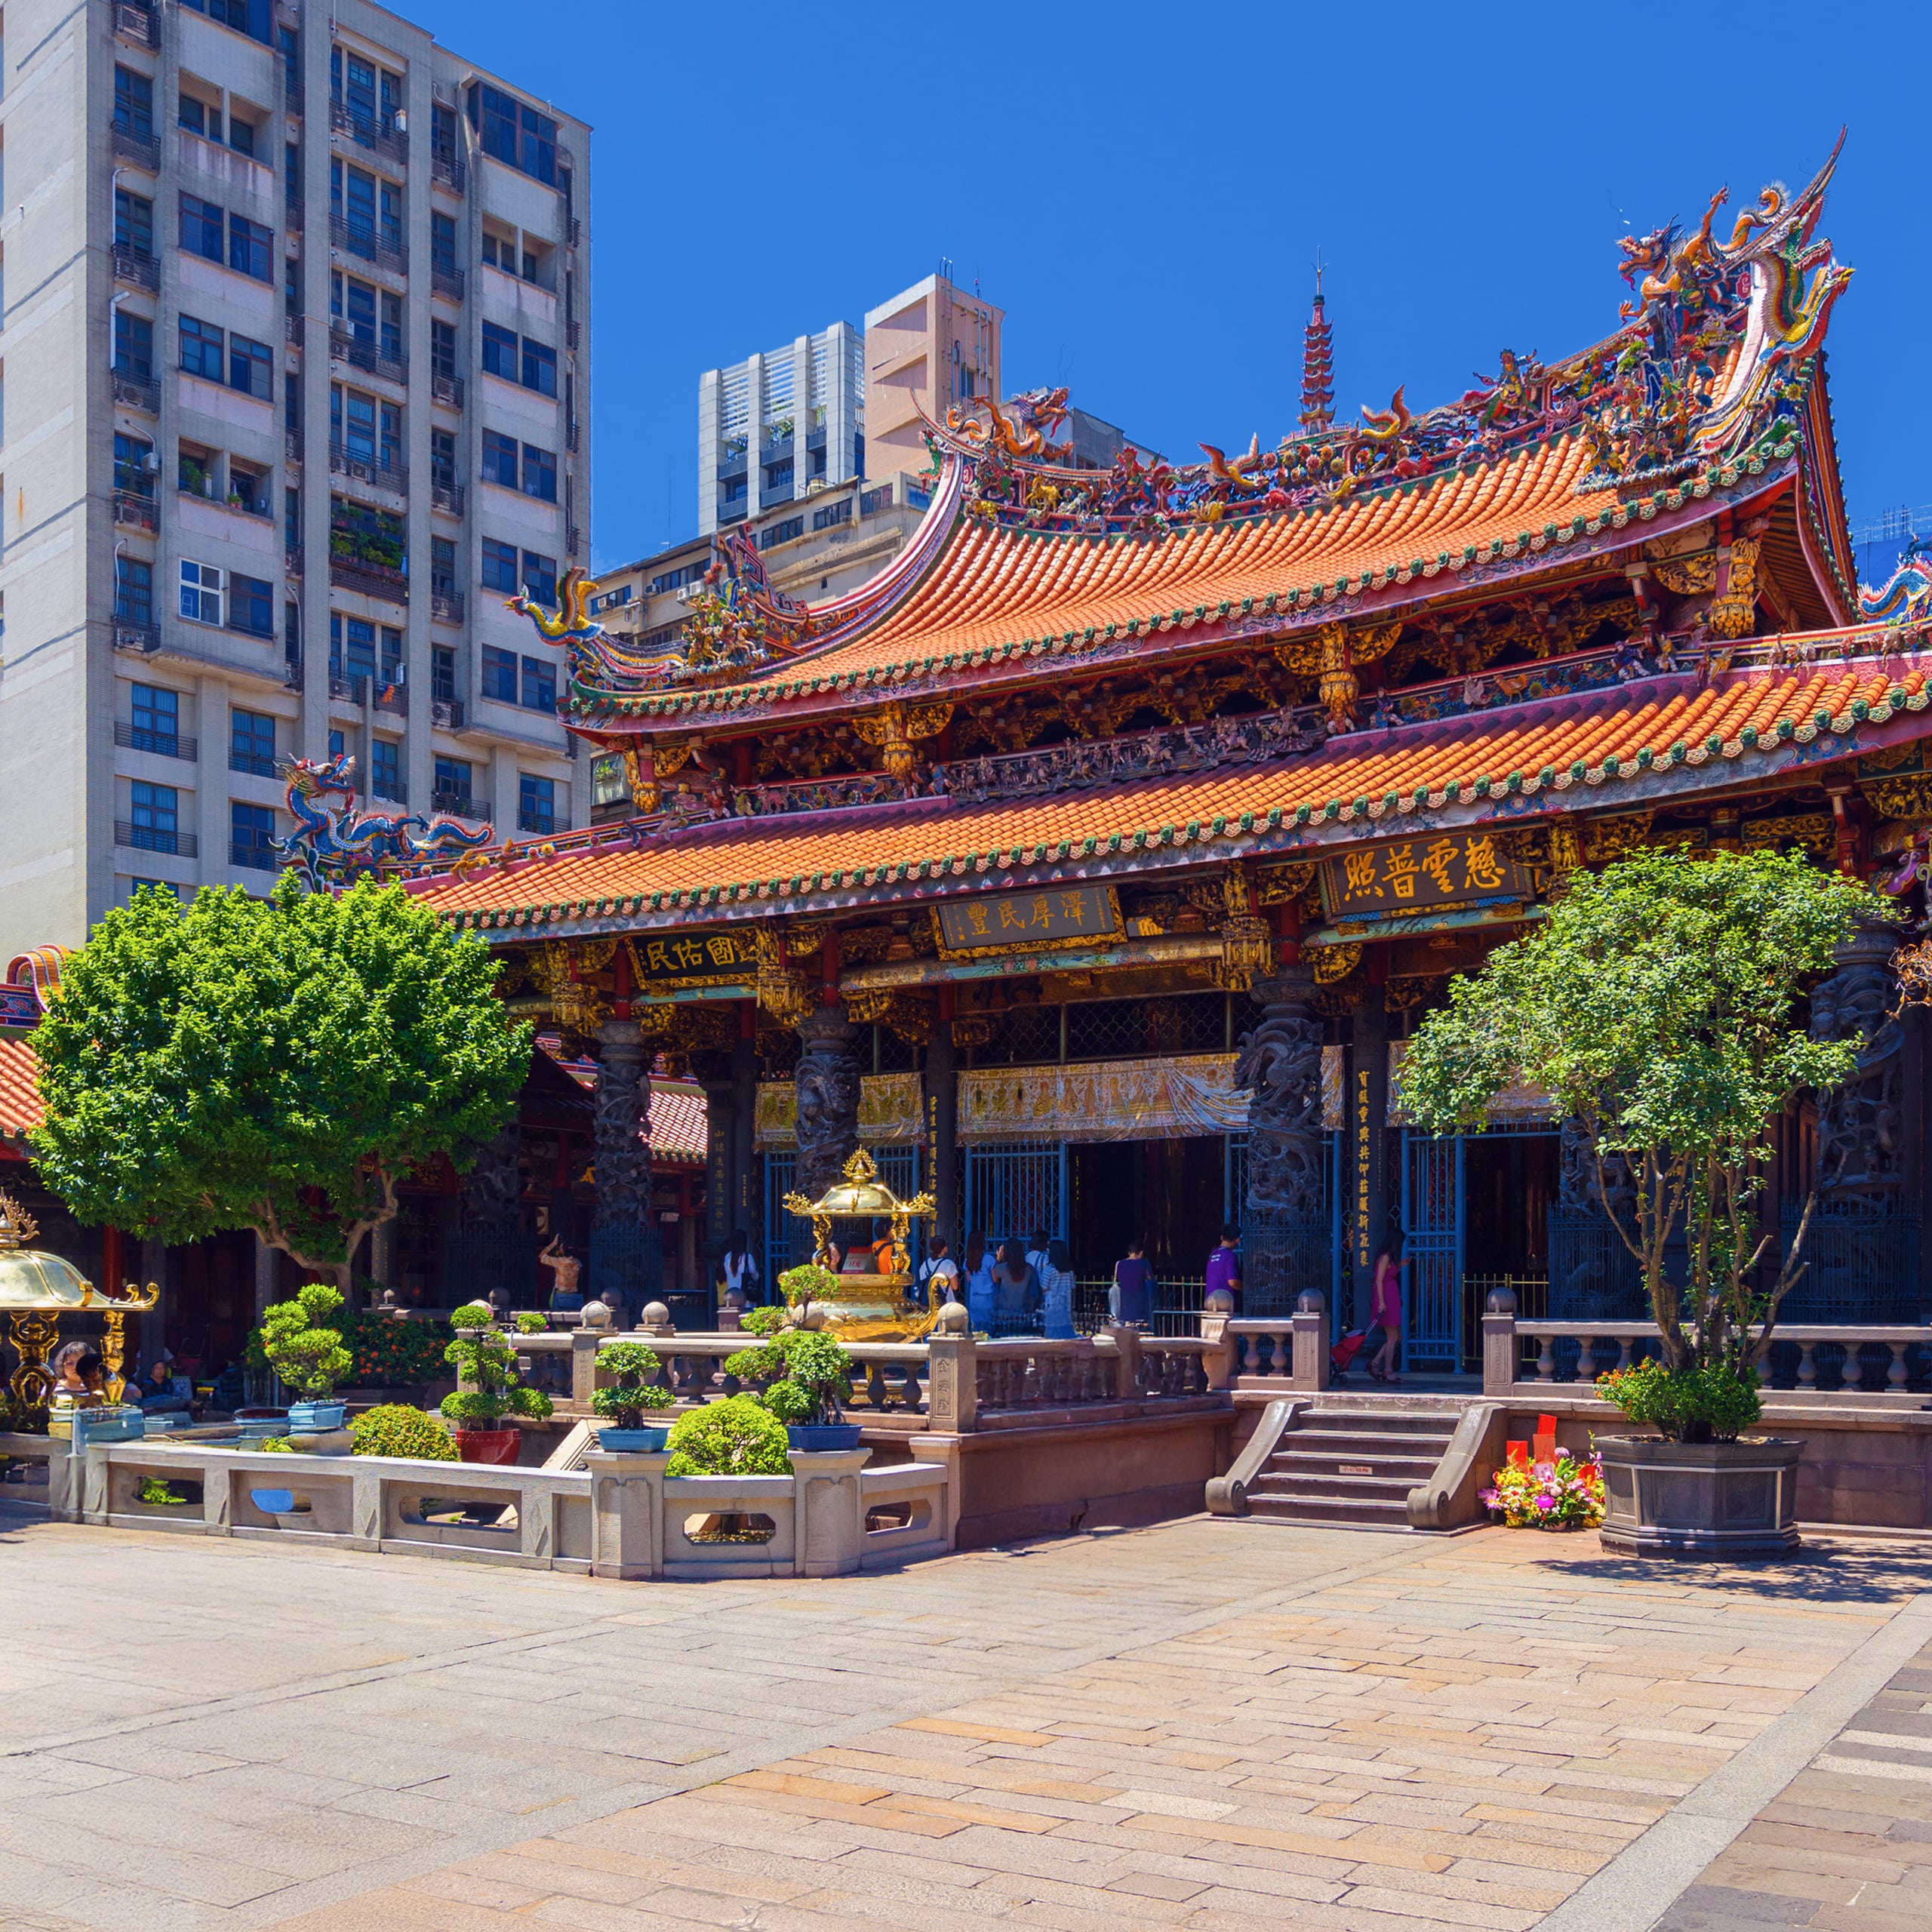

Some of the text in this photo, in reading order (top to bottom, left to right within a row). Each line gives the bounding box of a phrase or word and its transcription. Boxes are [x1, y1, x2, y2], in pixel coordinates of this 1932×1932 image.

[1344, 835, 1506, 902] 慈雲普照
[966, 891, 1087, 936] 澤厚民豐
